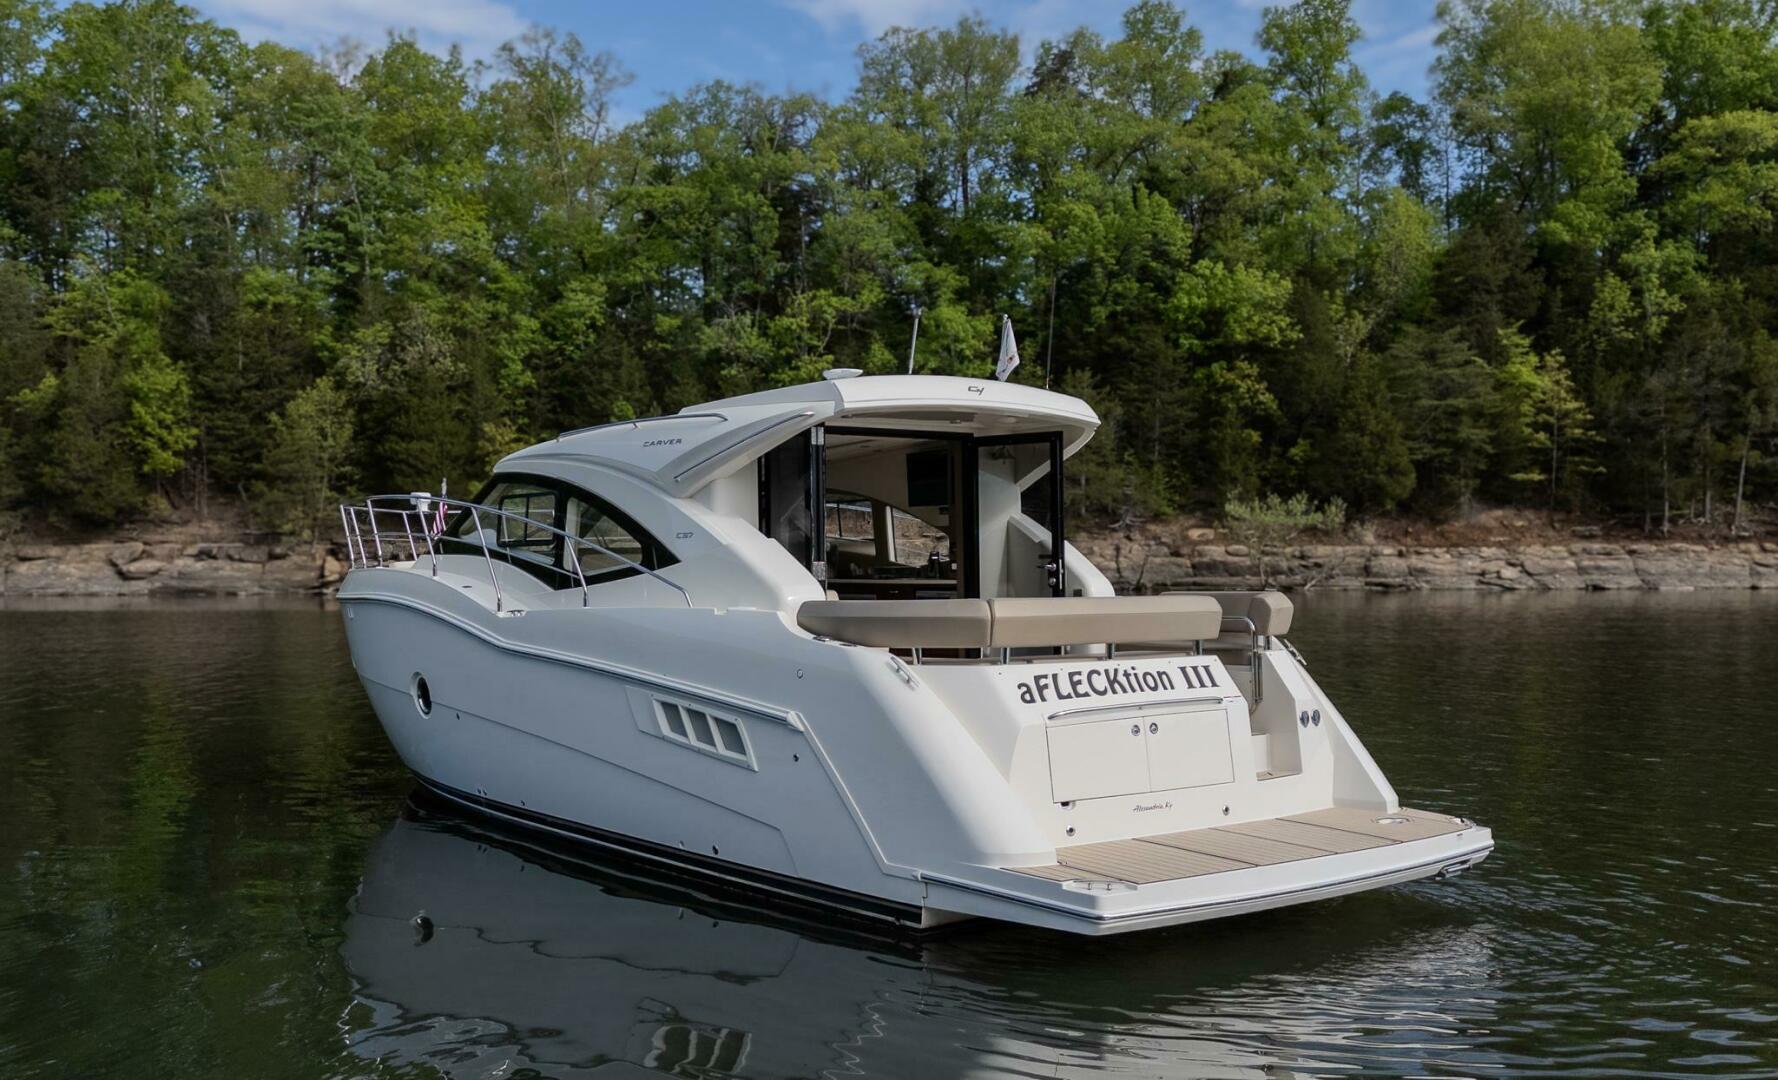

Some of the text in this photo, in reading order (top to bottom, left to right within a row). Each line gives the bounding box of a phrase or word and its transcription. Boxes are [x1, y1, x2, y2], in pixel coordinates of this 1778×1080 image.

[642, 438, 682, 448] CARVER
[1017, 665, 1220, 704] aFLECKtion III
